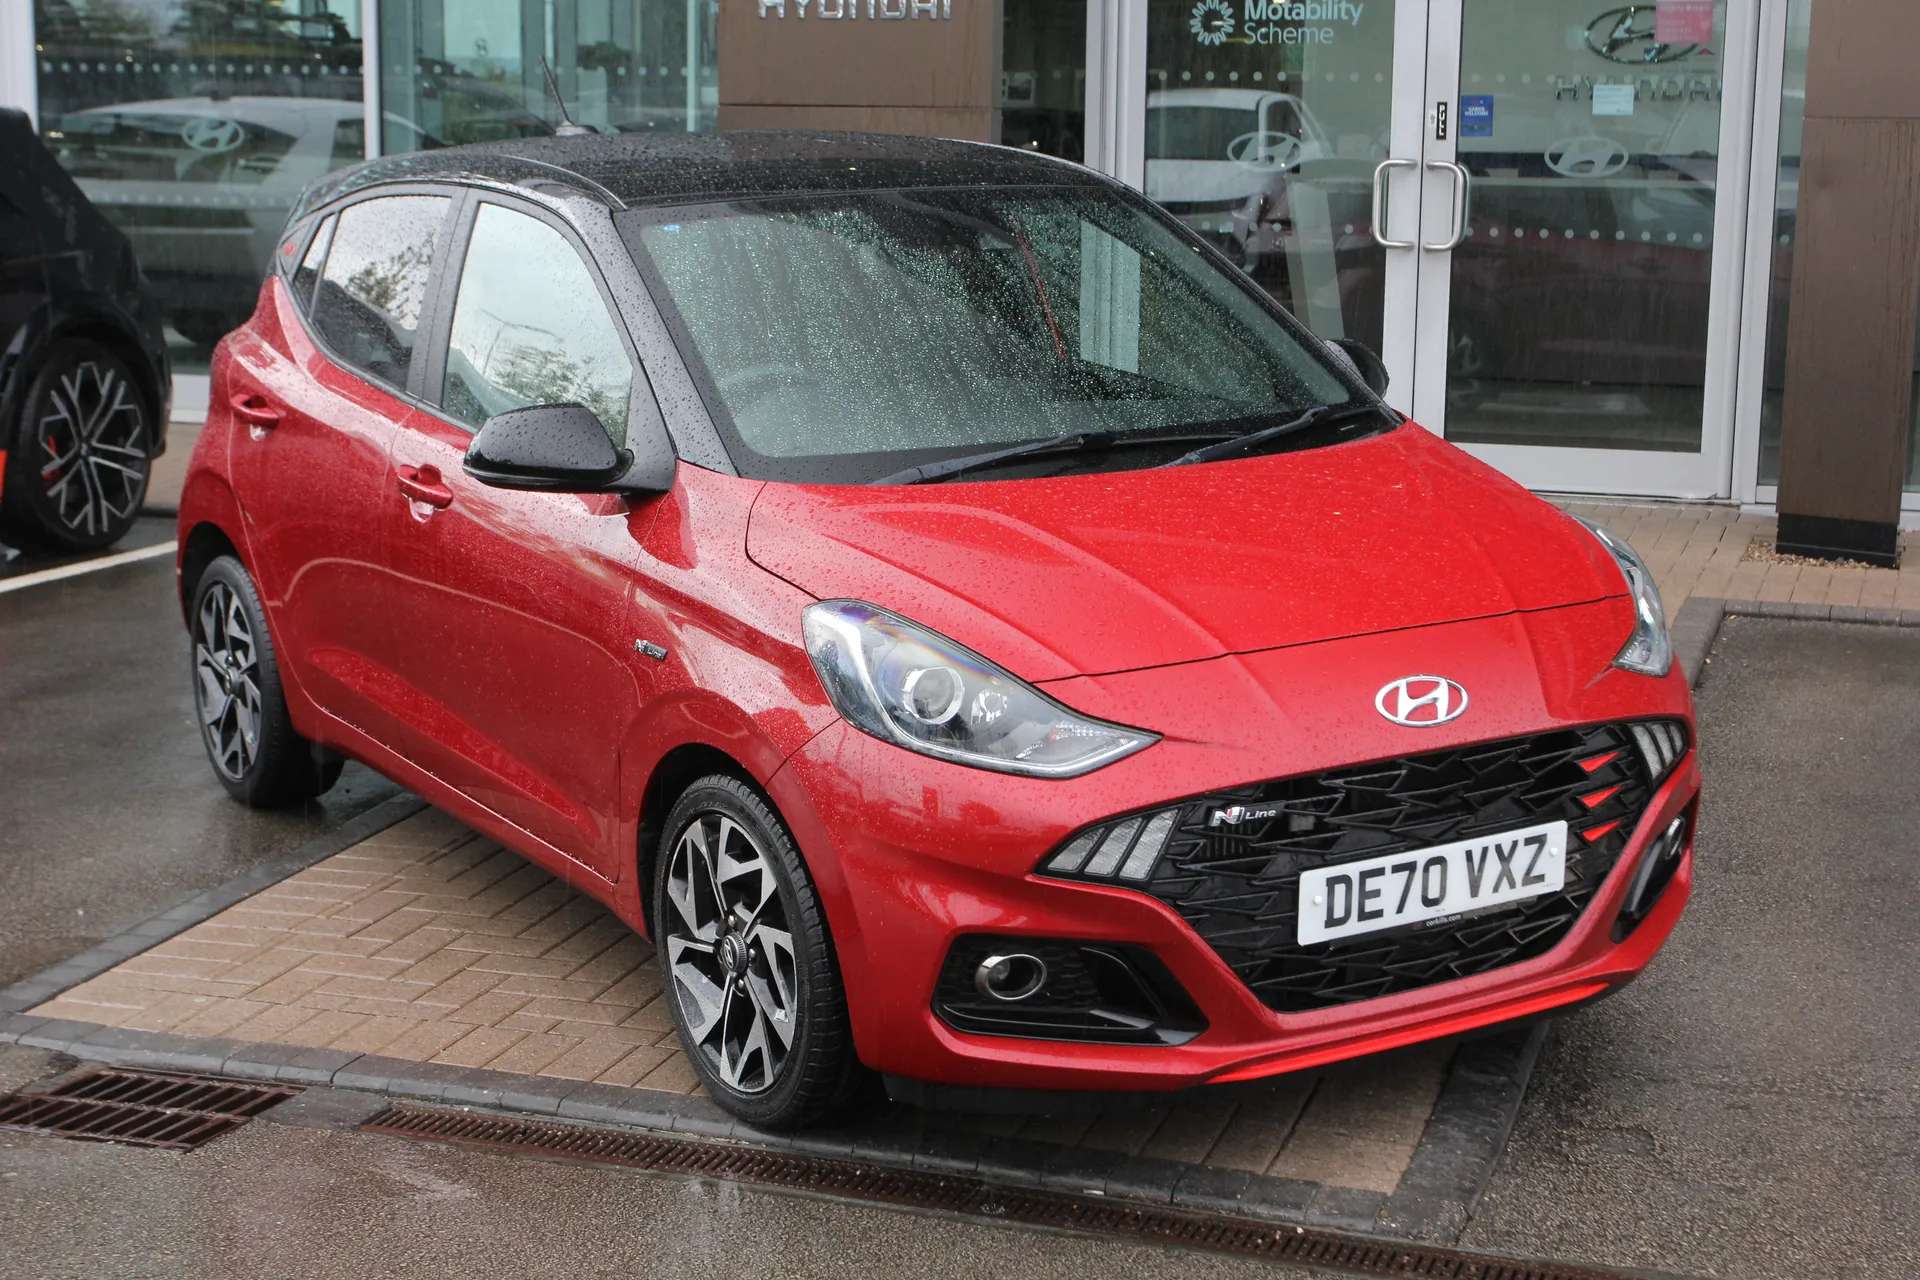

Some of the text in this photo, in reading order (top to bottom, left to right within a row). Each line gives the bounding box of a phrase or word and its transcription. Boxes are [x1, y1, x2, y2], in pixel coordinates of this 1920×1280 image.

[1244, 0, 1364, 26] Motability
[1244, 22, 1334, 44] Scheme
[1438, 103, 1446, 137] PULL
[1245, 809, 1277, 820] Line
[1324, 833, 1548, 929] DE70 VXZ
